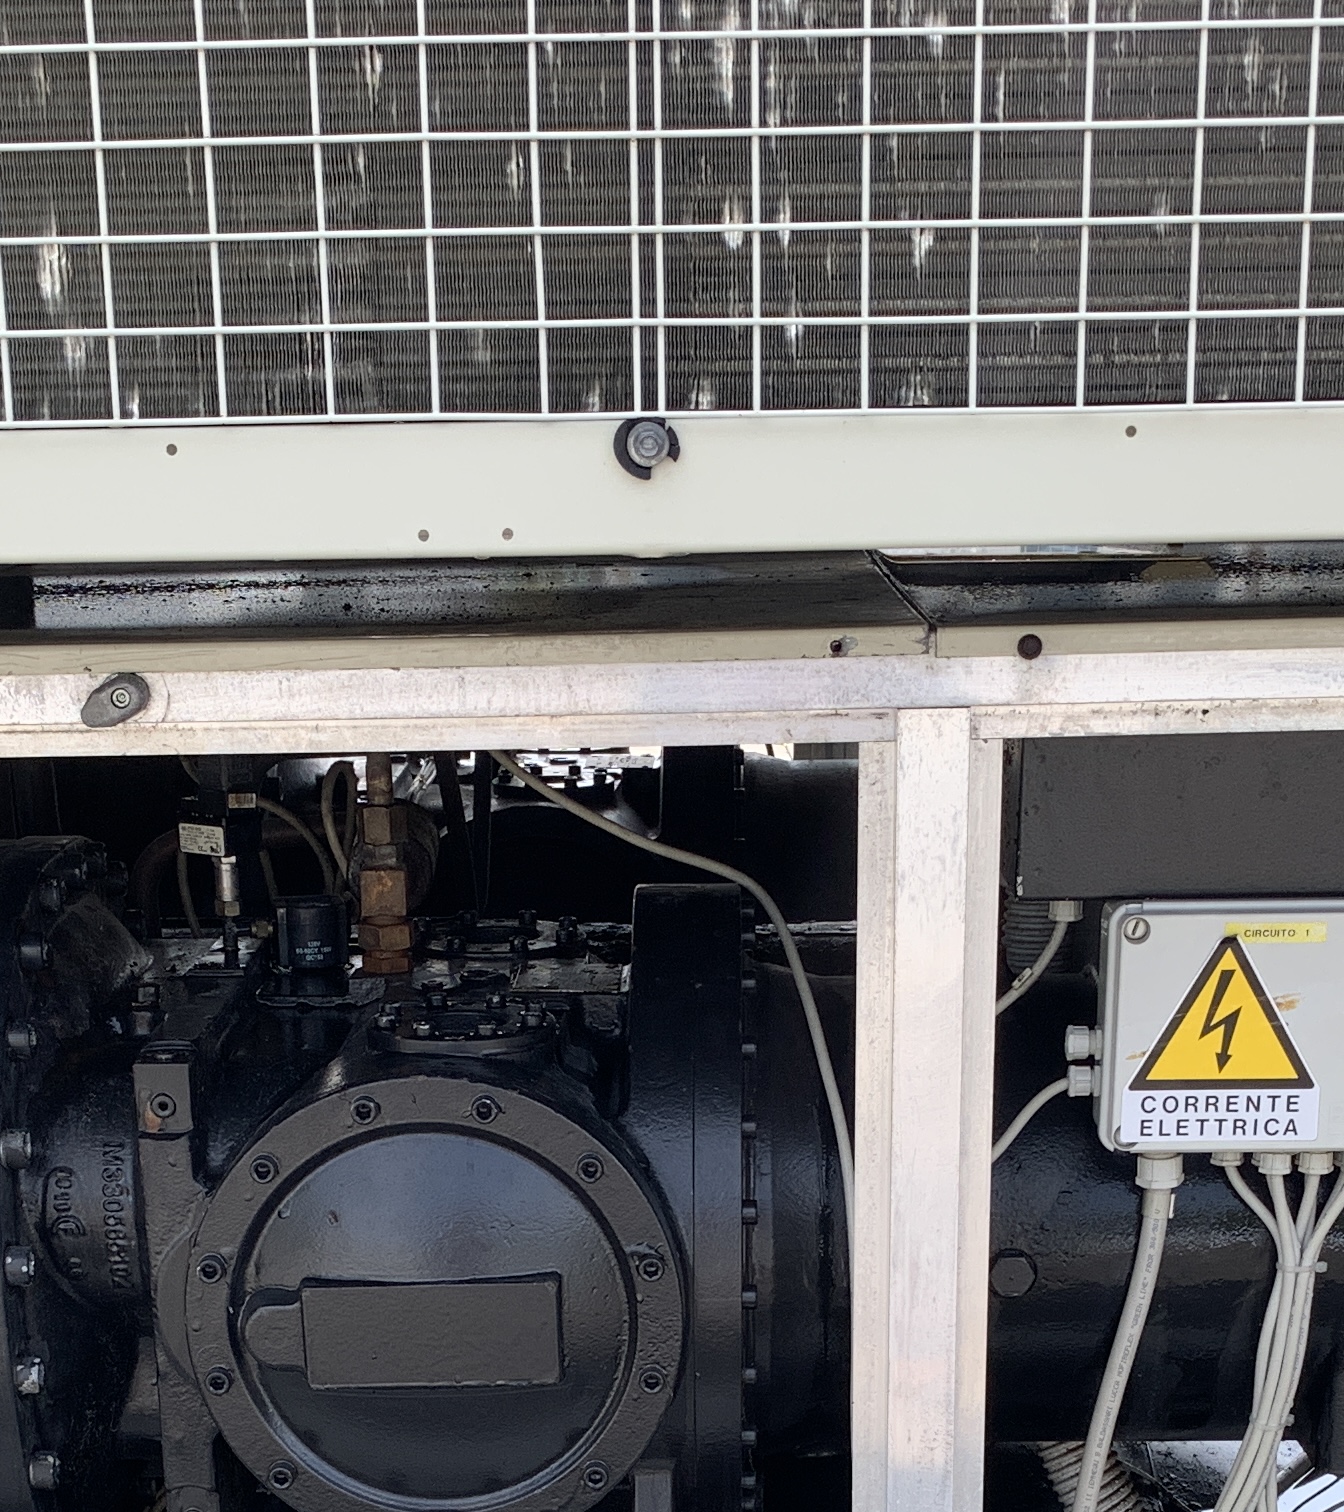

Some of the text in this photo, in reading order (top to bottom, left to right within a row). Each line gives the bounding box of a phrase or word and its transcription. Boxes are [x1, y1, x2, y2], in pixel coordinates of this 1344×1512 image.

[1243, 929, 1310, 938] CIRCUITO 1
[1140, 1095, 1301, 1114] CORRENTE
[1139, 1118, 1299, 1137] ELETTRICA
